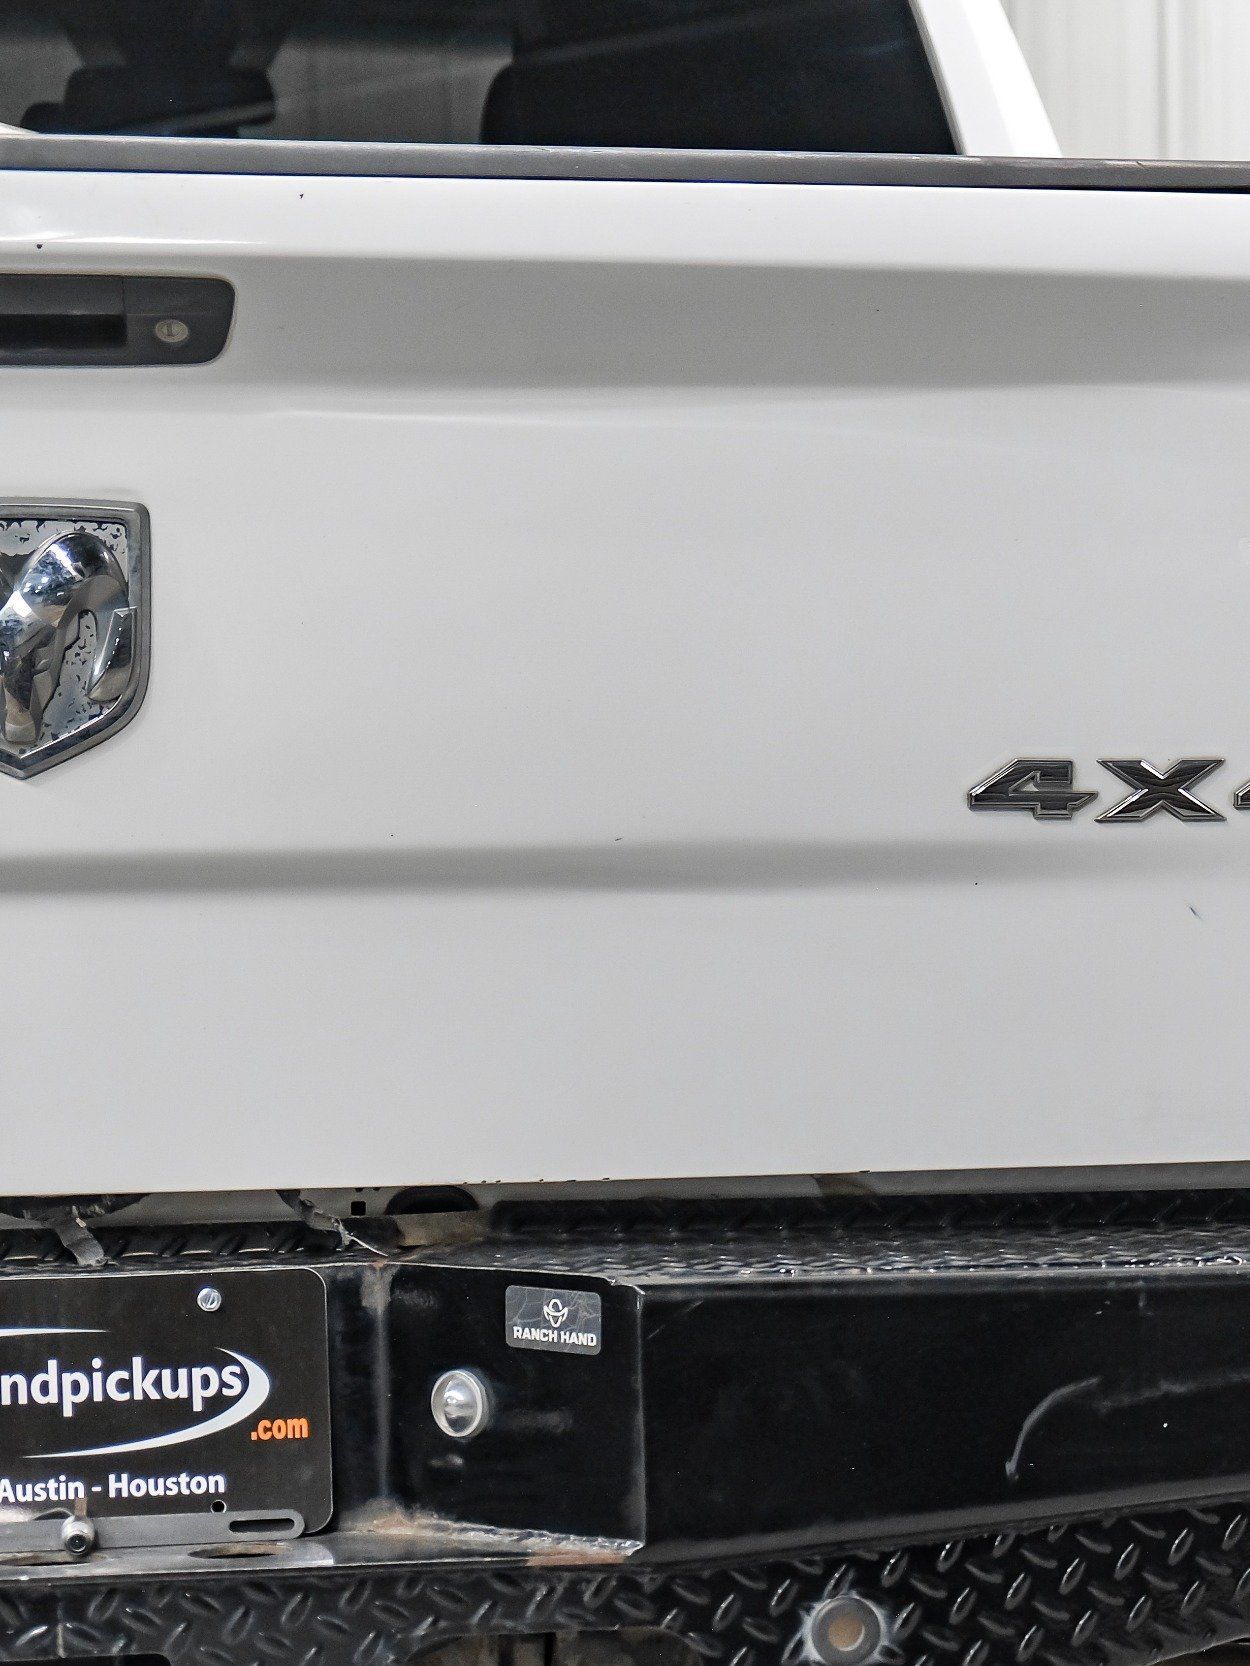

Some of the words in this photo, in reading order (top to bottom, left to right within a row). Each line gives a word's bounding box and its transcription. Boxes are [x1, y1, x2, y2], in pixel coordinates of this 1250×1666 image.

[513, 1326, 557, 1342] RANCH
[560, 1330, 597, 1346] HAND
[0, 1356, 243, 1417] ndpickups
[251, 1417, 309, 1440] .com
[0, 1475, 84, 1503] Austin
[108, 1473, 225, 1498] Houston
